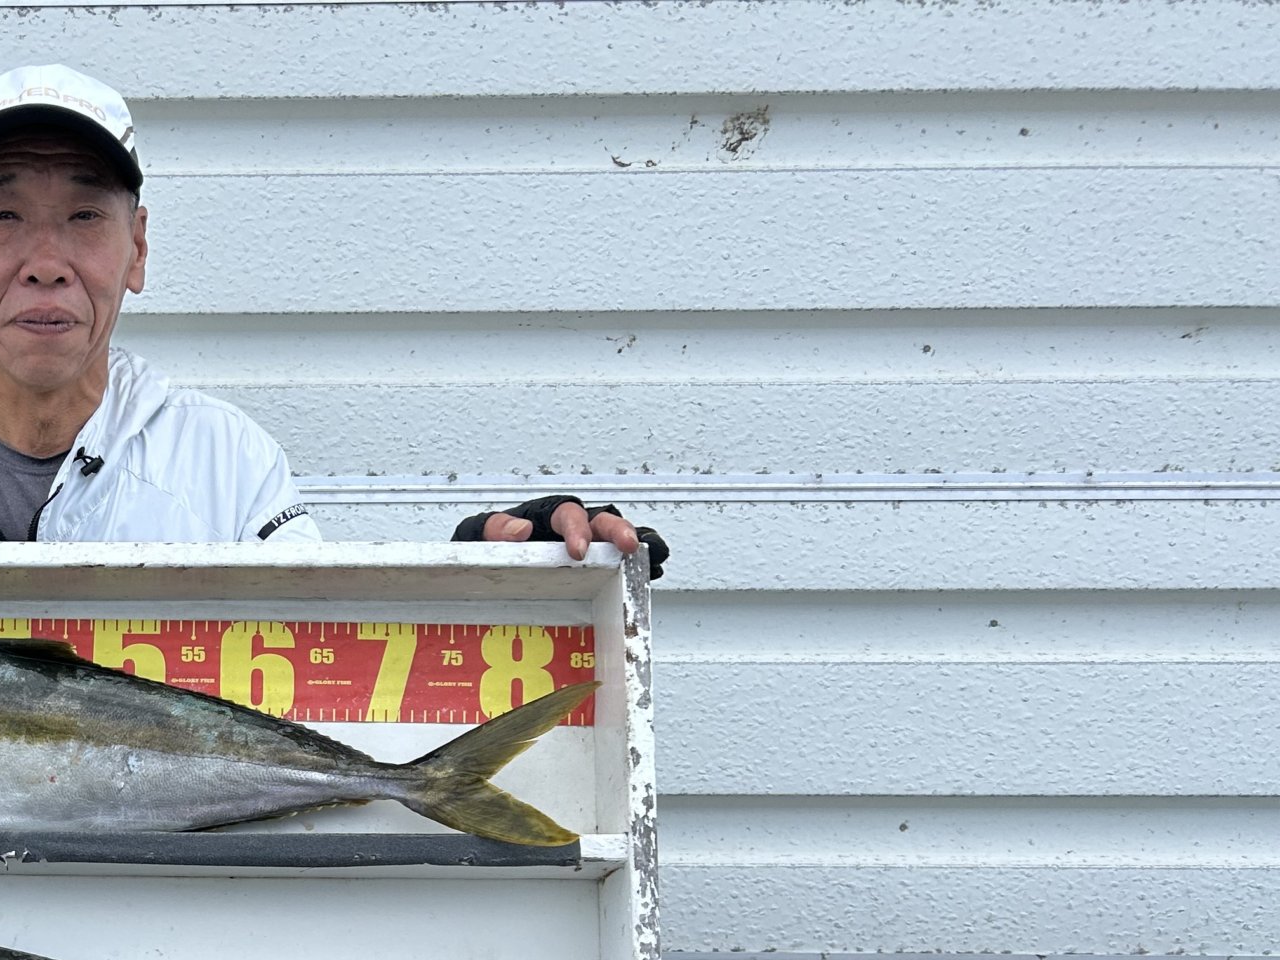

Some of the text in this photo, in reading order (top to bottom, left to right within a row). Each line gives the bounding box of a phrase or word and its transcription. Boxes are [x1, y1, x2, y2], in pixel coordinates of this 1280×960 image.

[181, 646, 205, 662] 55
[221, 621, 295, 719] 6
[309, 648, 335, 664] 65
[357, 623, 417, 722] 7
[440, 650, 463, 666] 75
[479, 625, 554, 720] 8
[570, 652, 595, 668] 85
